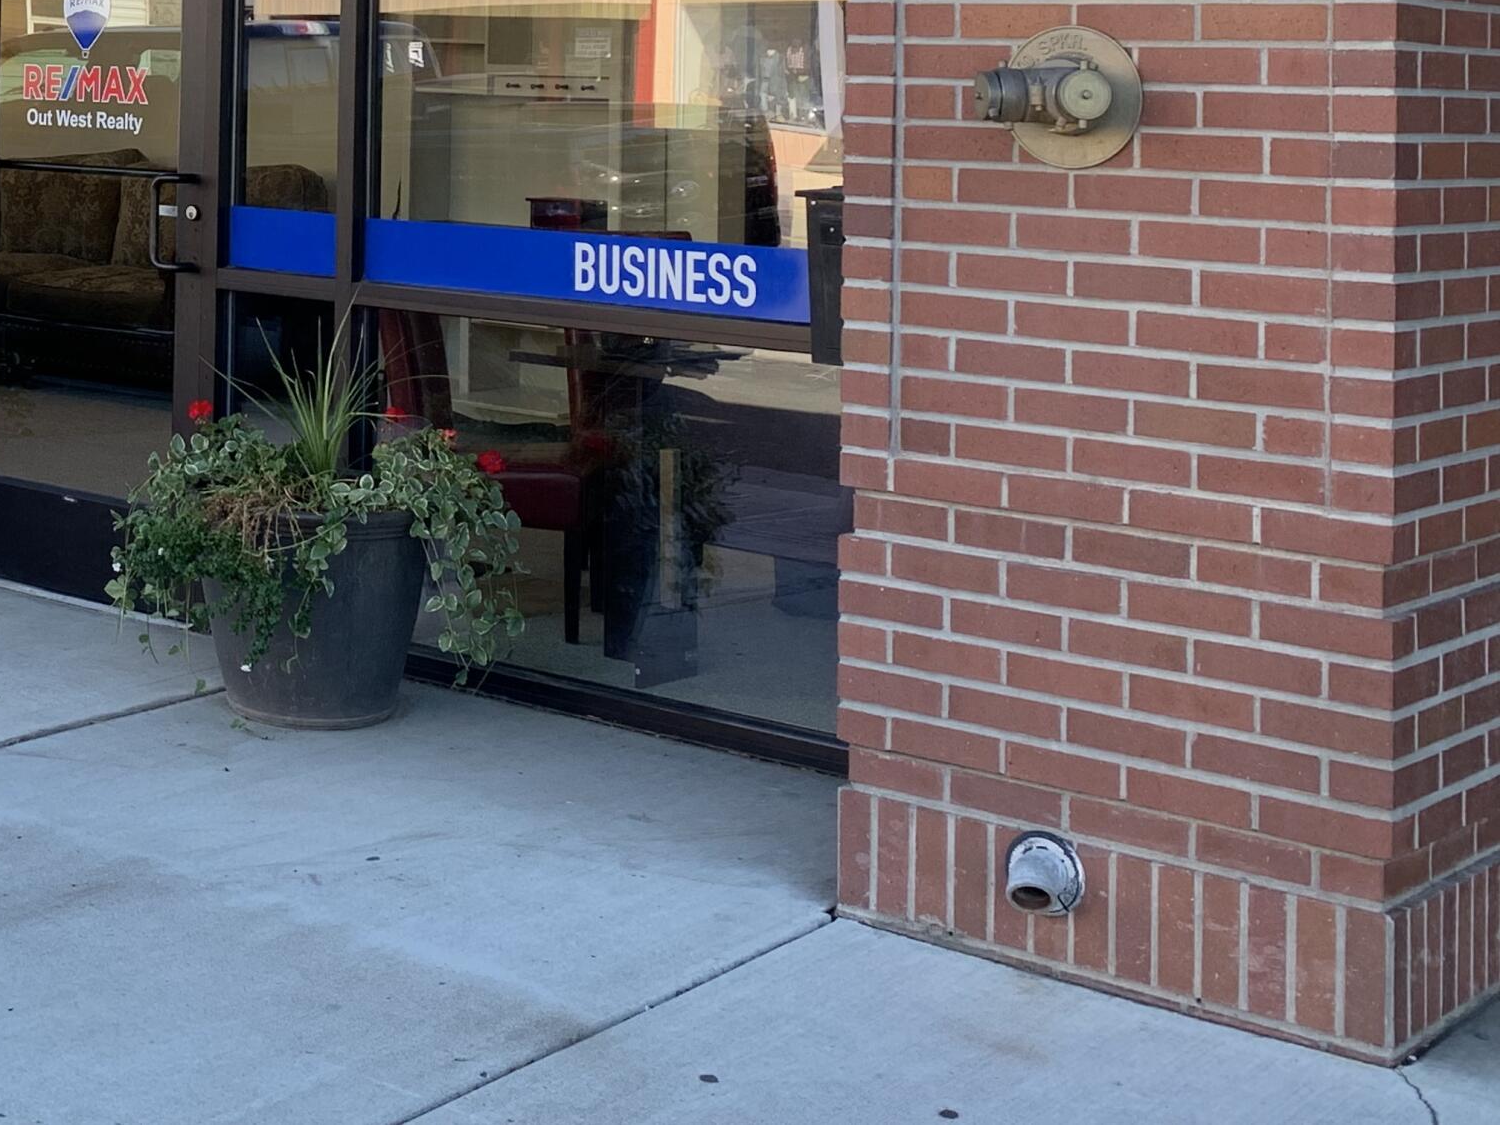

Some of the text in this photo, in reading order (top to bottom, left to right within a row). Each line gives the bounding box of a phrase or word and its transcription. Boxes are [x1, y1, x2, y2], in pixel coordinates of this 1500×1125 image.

[22, 63, 148, 105] RE/MAX
[26, 108, 143, 135] Out West Realty
[574, 241, 757, 308] BUSINESS
